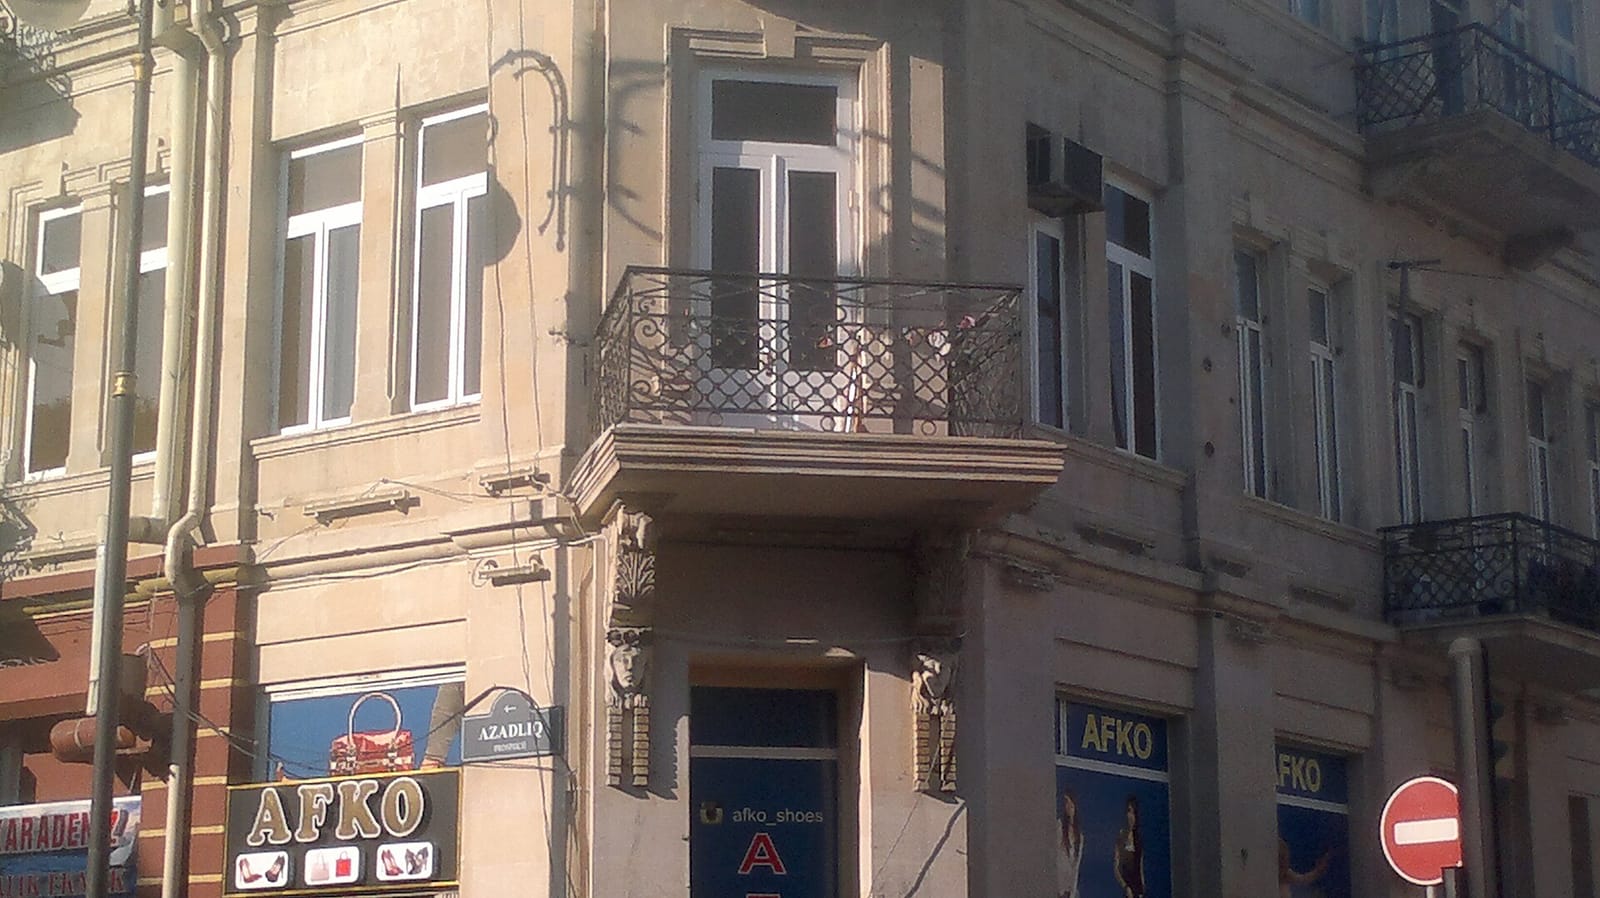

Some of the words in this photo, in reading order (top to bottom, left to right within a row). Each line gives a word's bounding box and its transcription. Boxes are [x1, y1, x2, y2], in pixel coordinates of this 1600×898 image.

[478, 721, 544, 740] AZADLIQ
[1081, 713, 1153, 760] AFKO
[1276, 753, 1321, 792] FKO
[247, 776, 425, 846] AFKO
[732, 807, 824, 826] afko_shoes
[738, 832, 787, 898] A
